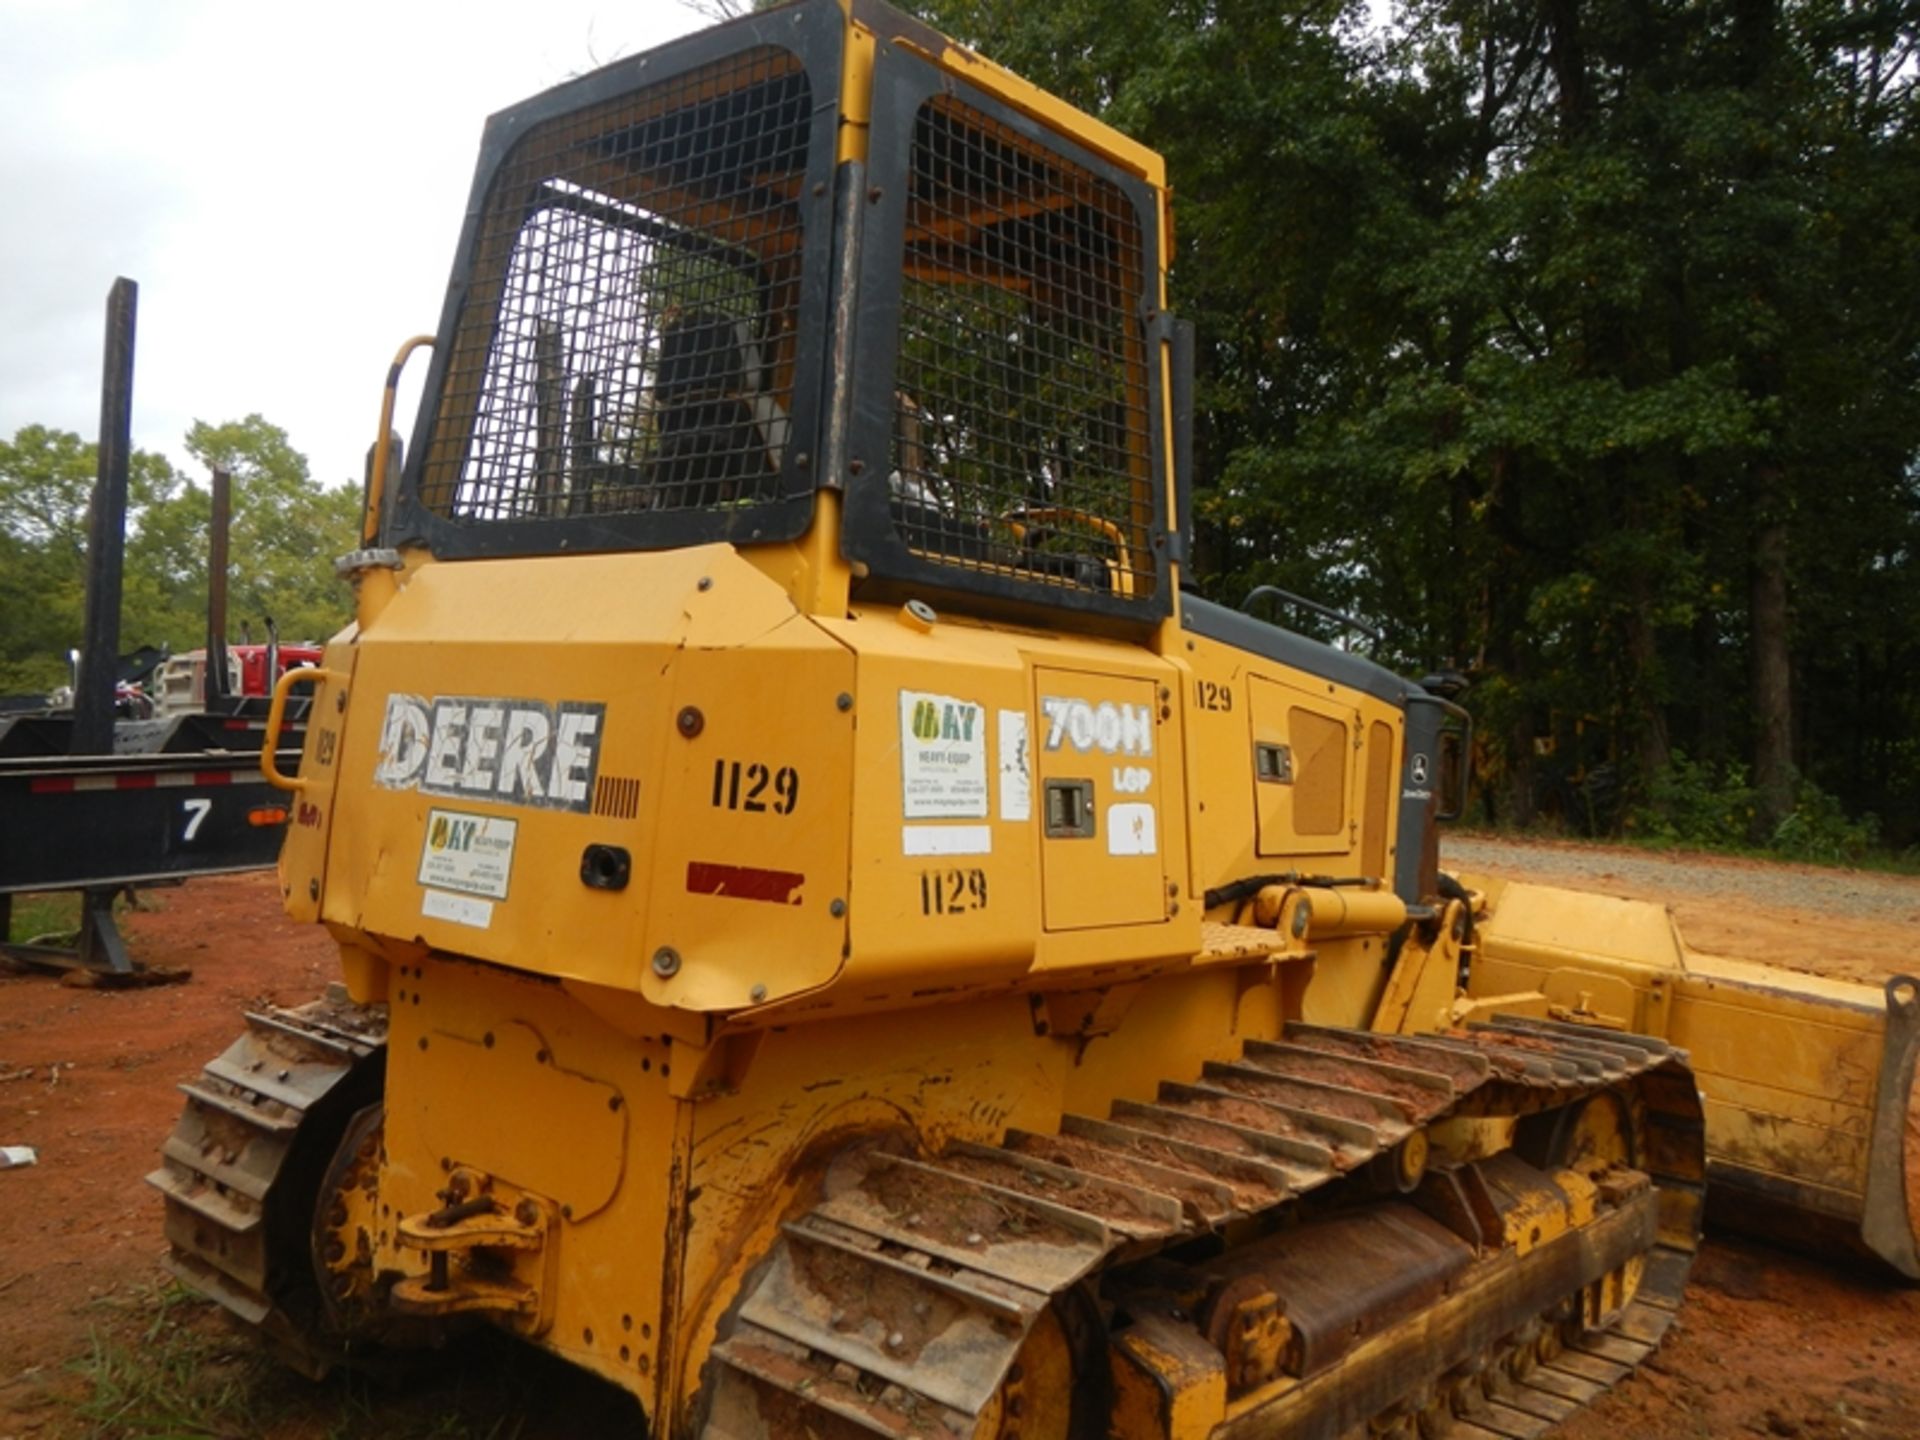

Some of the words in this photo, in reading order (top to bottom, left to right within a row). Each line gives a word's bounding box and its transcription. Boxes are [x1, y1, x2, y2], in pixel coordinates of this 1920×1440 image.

[378, 697, 602, 808] DEERE
[1042, 697, 1154, 757] 700H
[712, 759, 799, 816] 1129
[1112, 766, 1152, 793] LGP
[183, 799, 211, 841] 7
[921, 868, 987, 916] 1129
